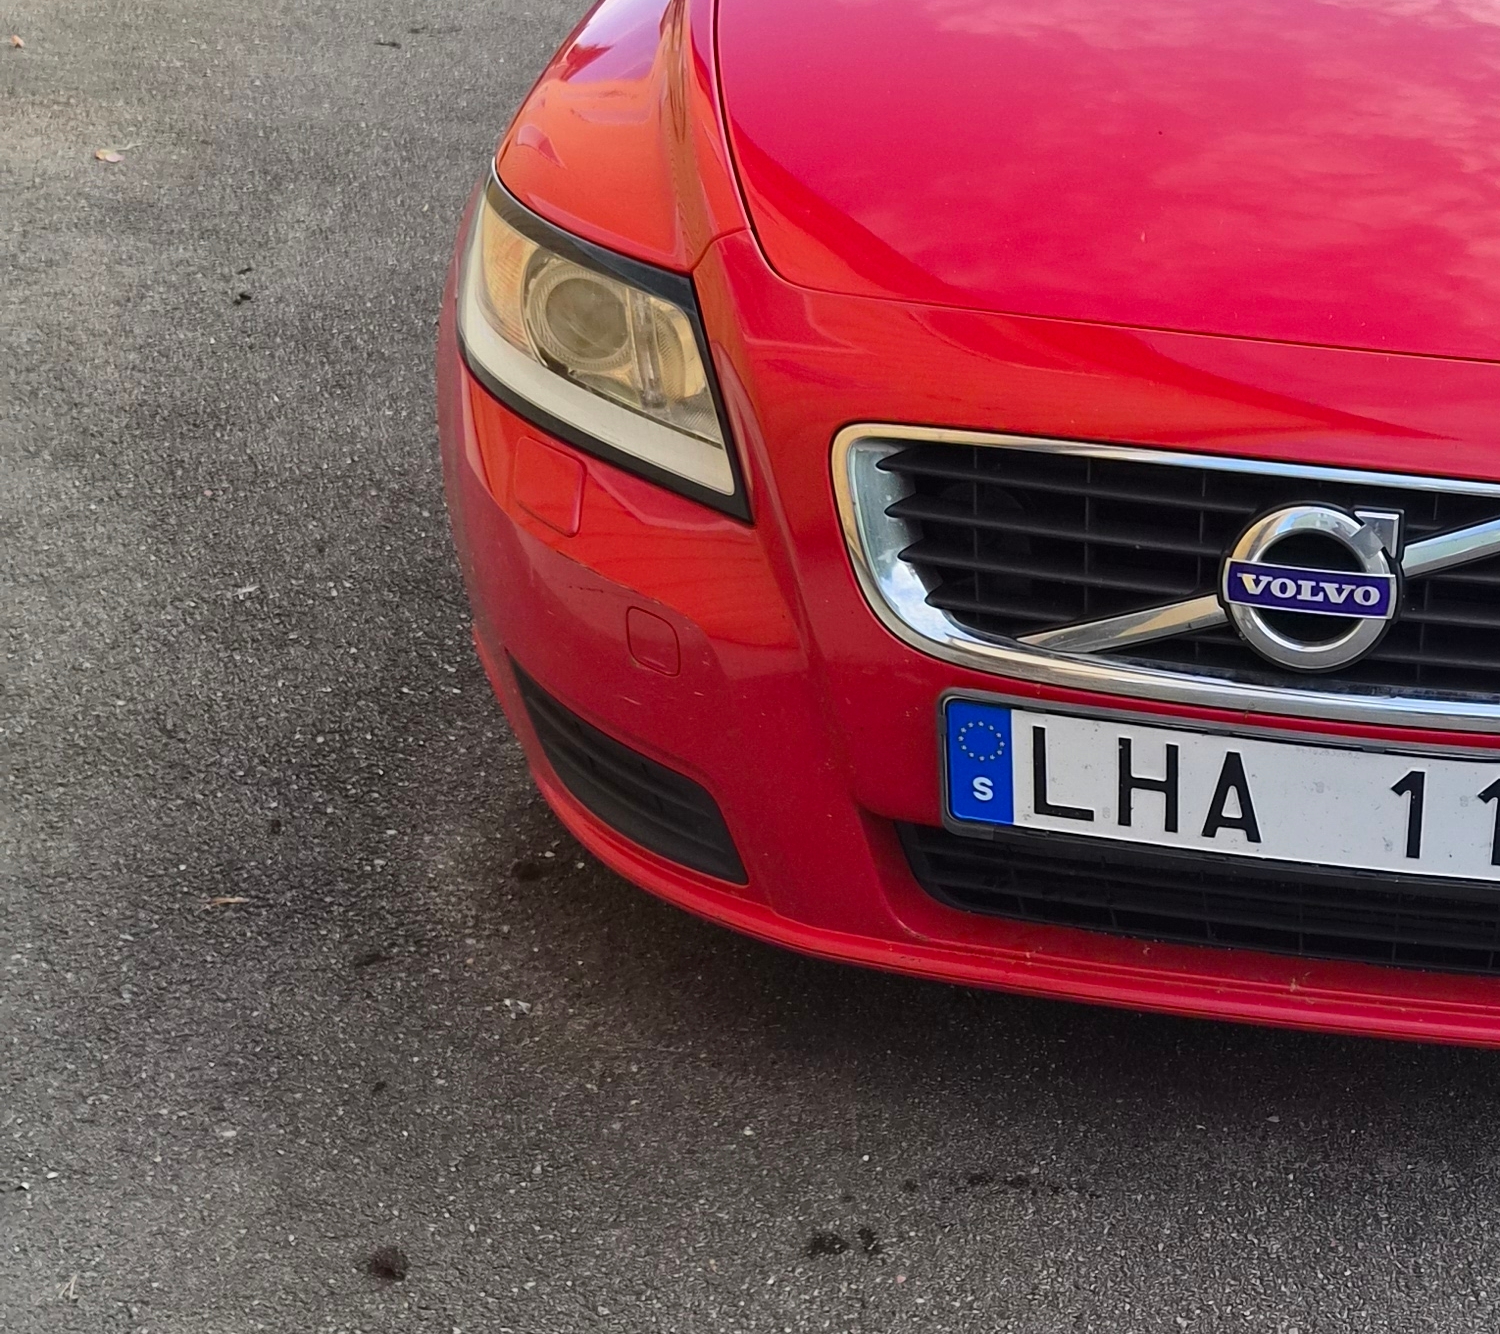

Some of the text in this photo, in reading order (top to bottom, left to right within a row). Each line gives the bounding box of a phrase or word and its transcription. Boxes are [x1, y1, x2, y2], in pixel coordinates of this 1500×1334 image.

[1236, 573, 1380, 606] VOLVO
[973, 776, 993, 801] S
[1032, 726, 1262, 843] LHA
